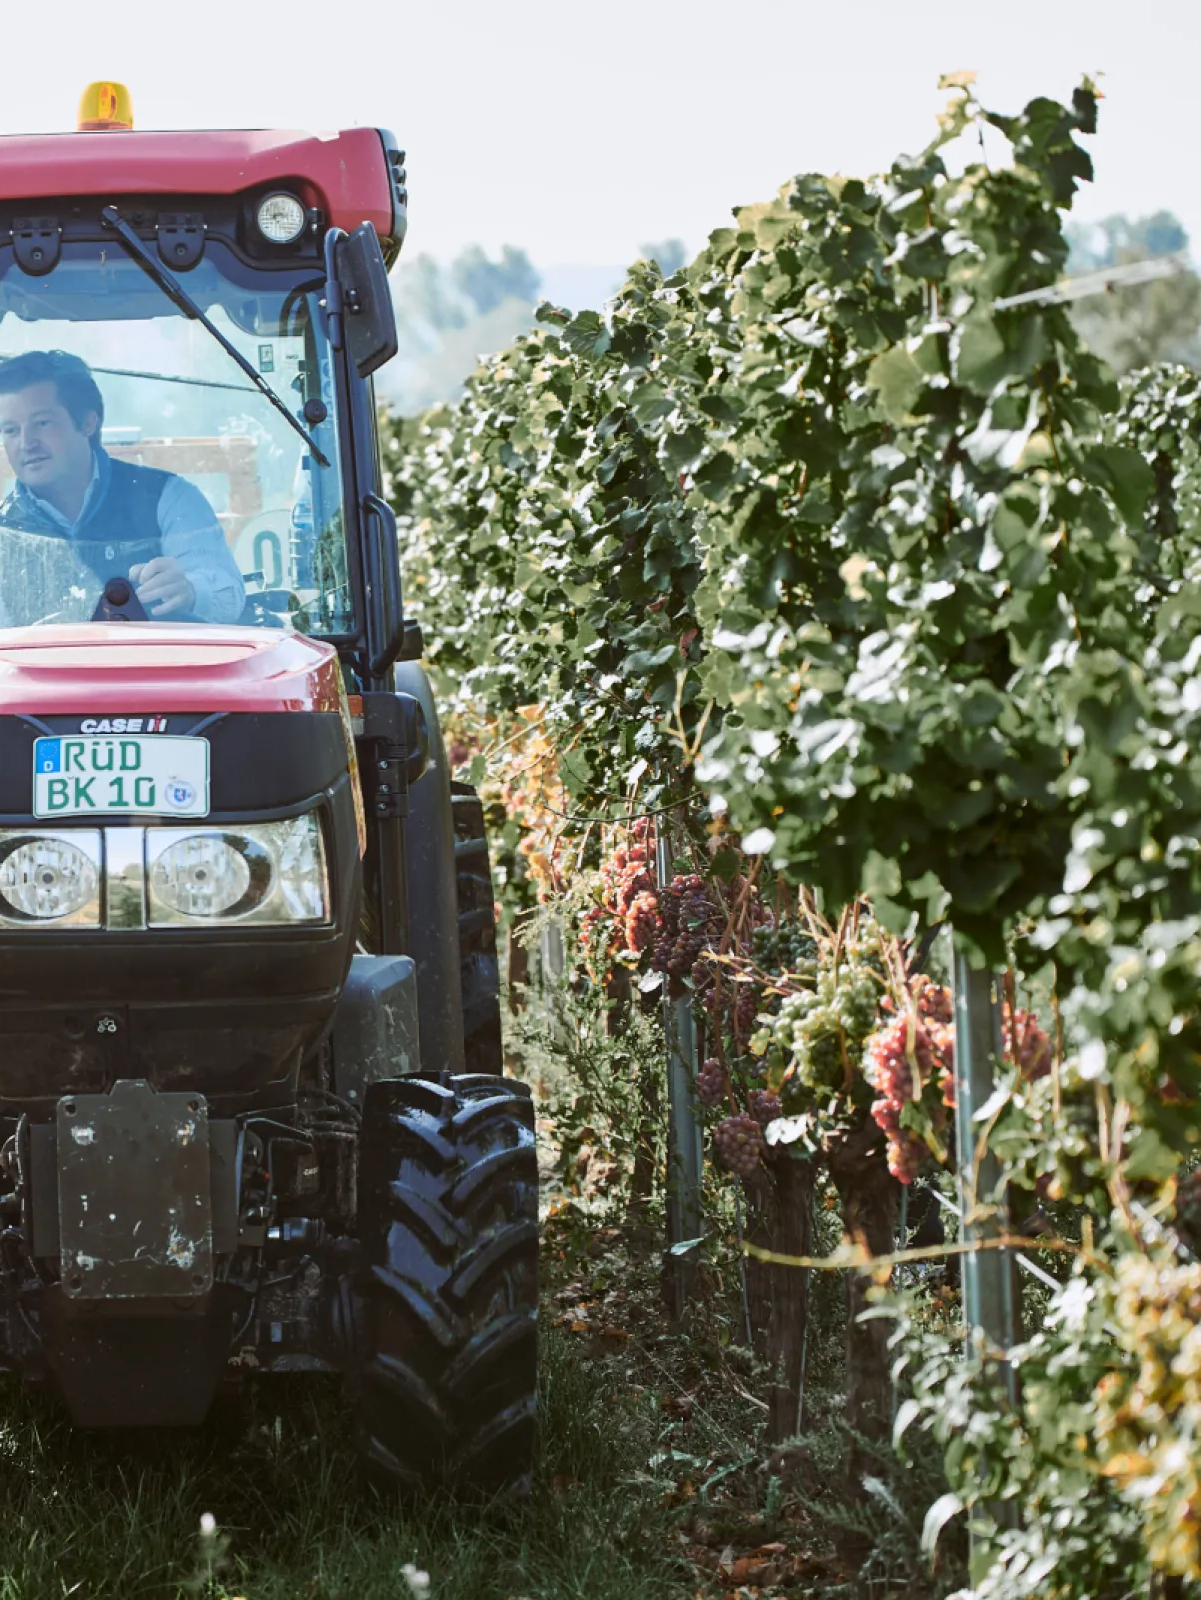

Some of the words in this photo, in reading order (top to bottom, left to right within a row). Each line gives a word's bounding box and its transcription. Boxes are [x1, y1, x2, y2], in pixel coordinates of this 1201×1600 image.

[80, 718, 143, 734] CASE
[43, 761, 54, 772] D
[64, 741, 141, 772] RÜD
[47, 776, 96, 810] BK
[107, 776, 155, 807] 10
